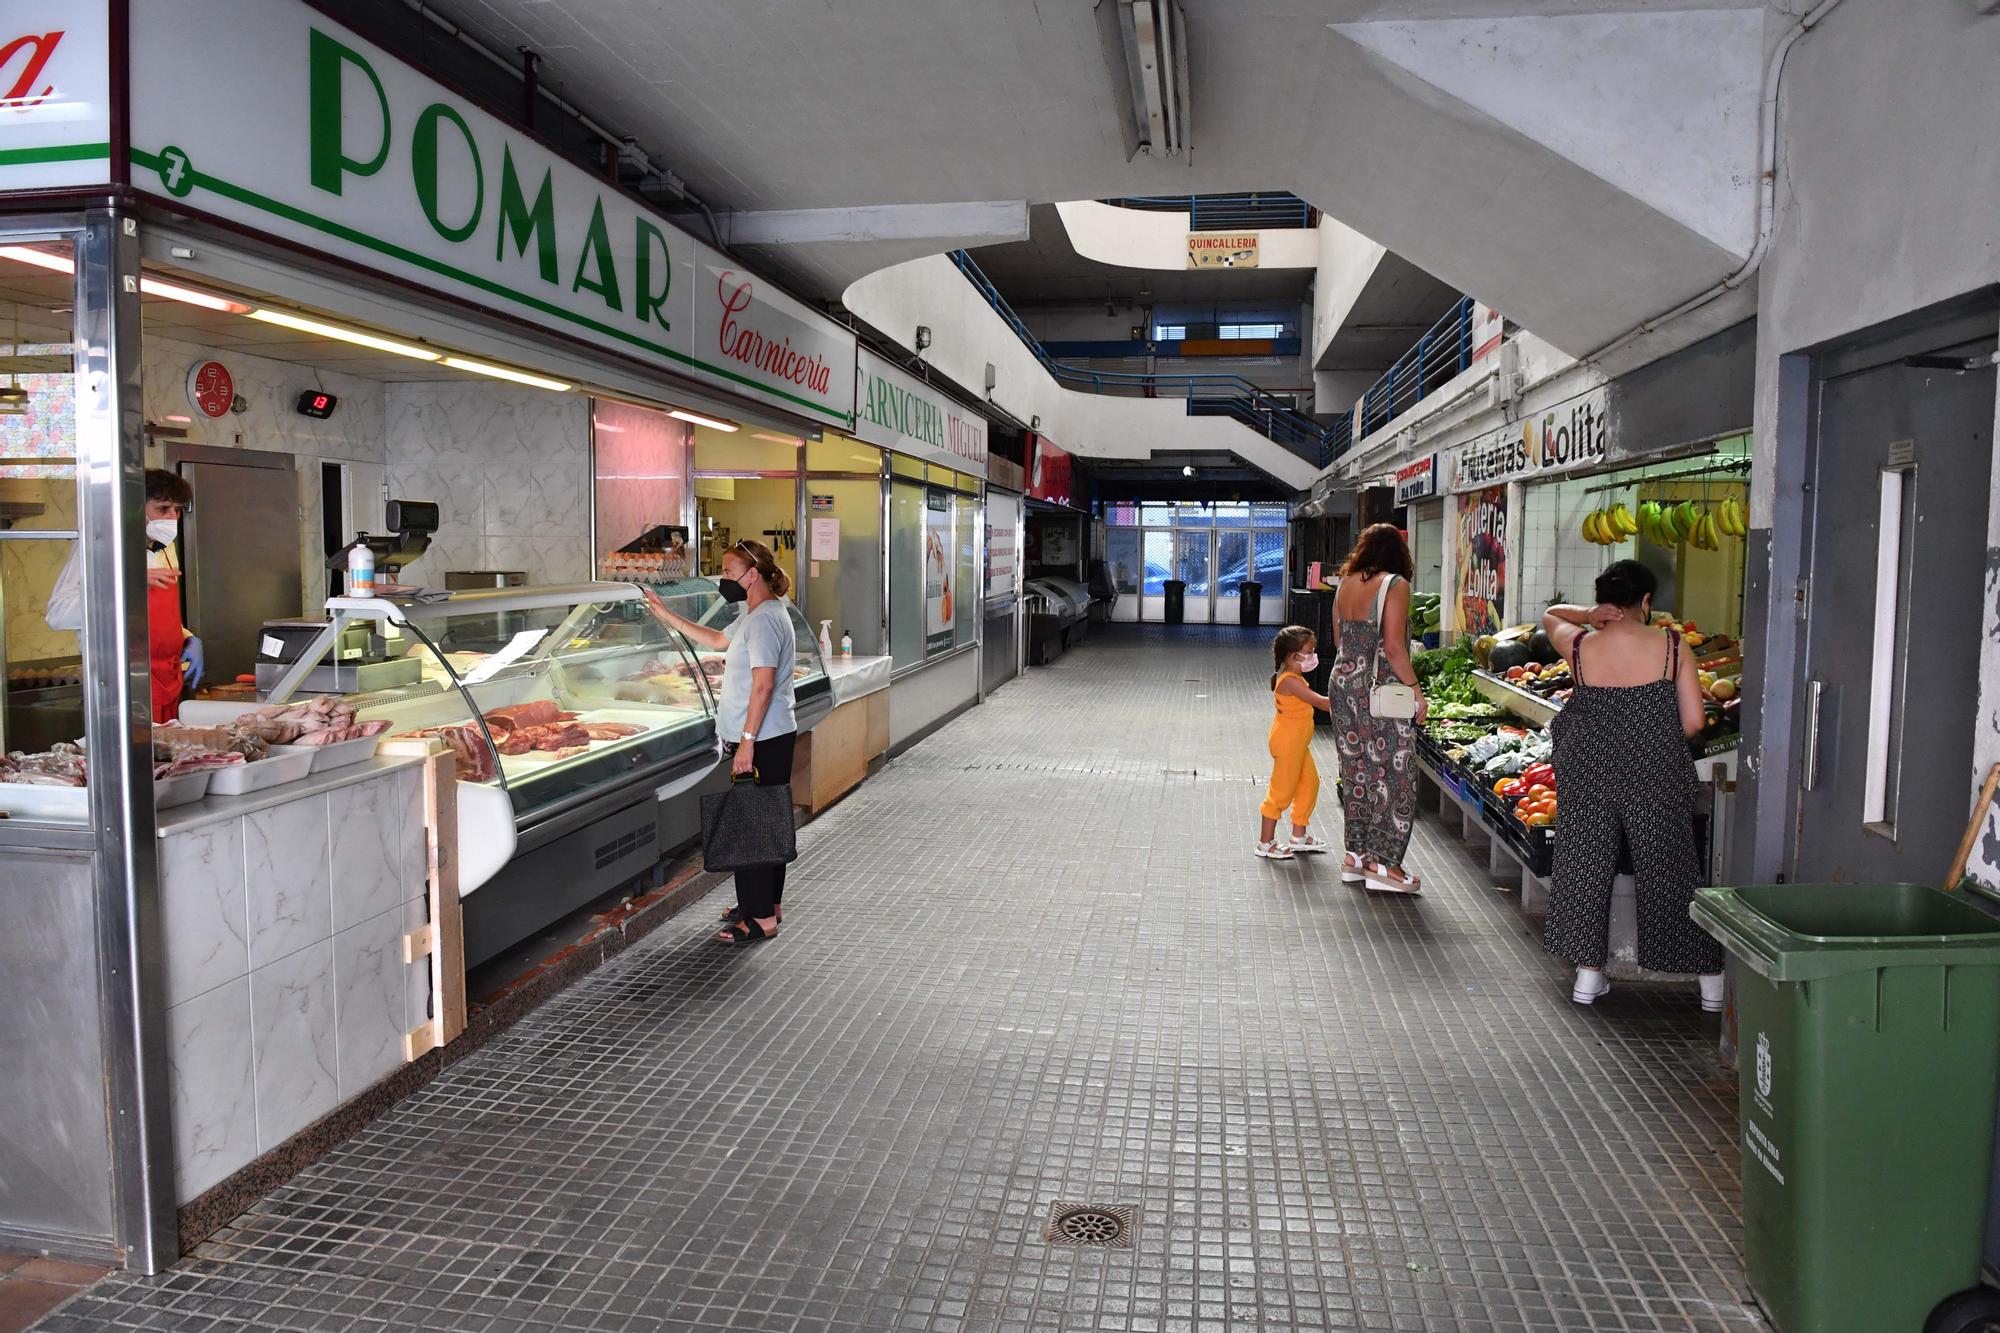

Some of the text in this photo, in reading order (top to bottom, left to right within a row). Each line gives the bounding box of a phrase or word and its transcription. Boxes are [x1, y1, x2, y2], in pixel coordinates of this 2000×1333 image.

[164, 151, 186, 189] 7
[310, 26, 671, 332] POMAR
[1189, 238, 1257, 250] QUINCALLERIA
[313, 395, 328, 409] 13
[947, 414, 984, 464] MIGUEL
[1542, 403, 1605, 468] Lolita
[1468, 558, 1498, 601] Lolita
